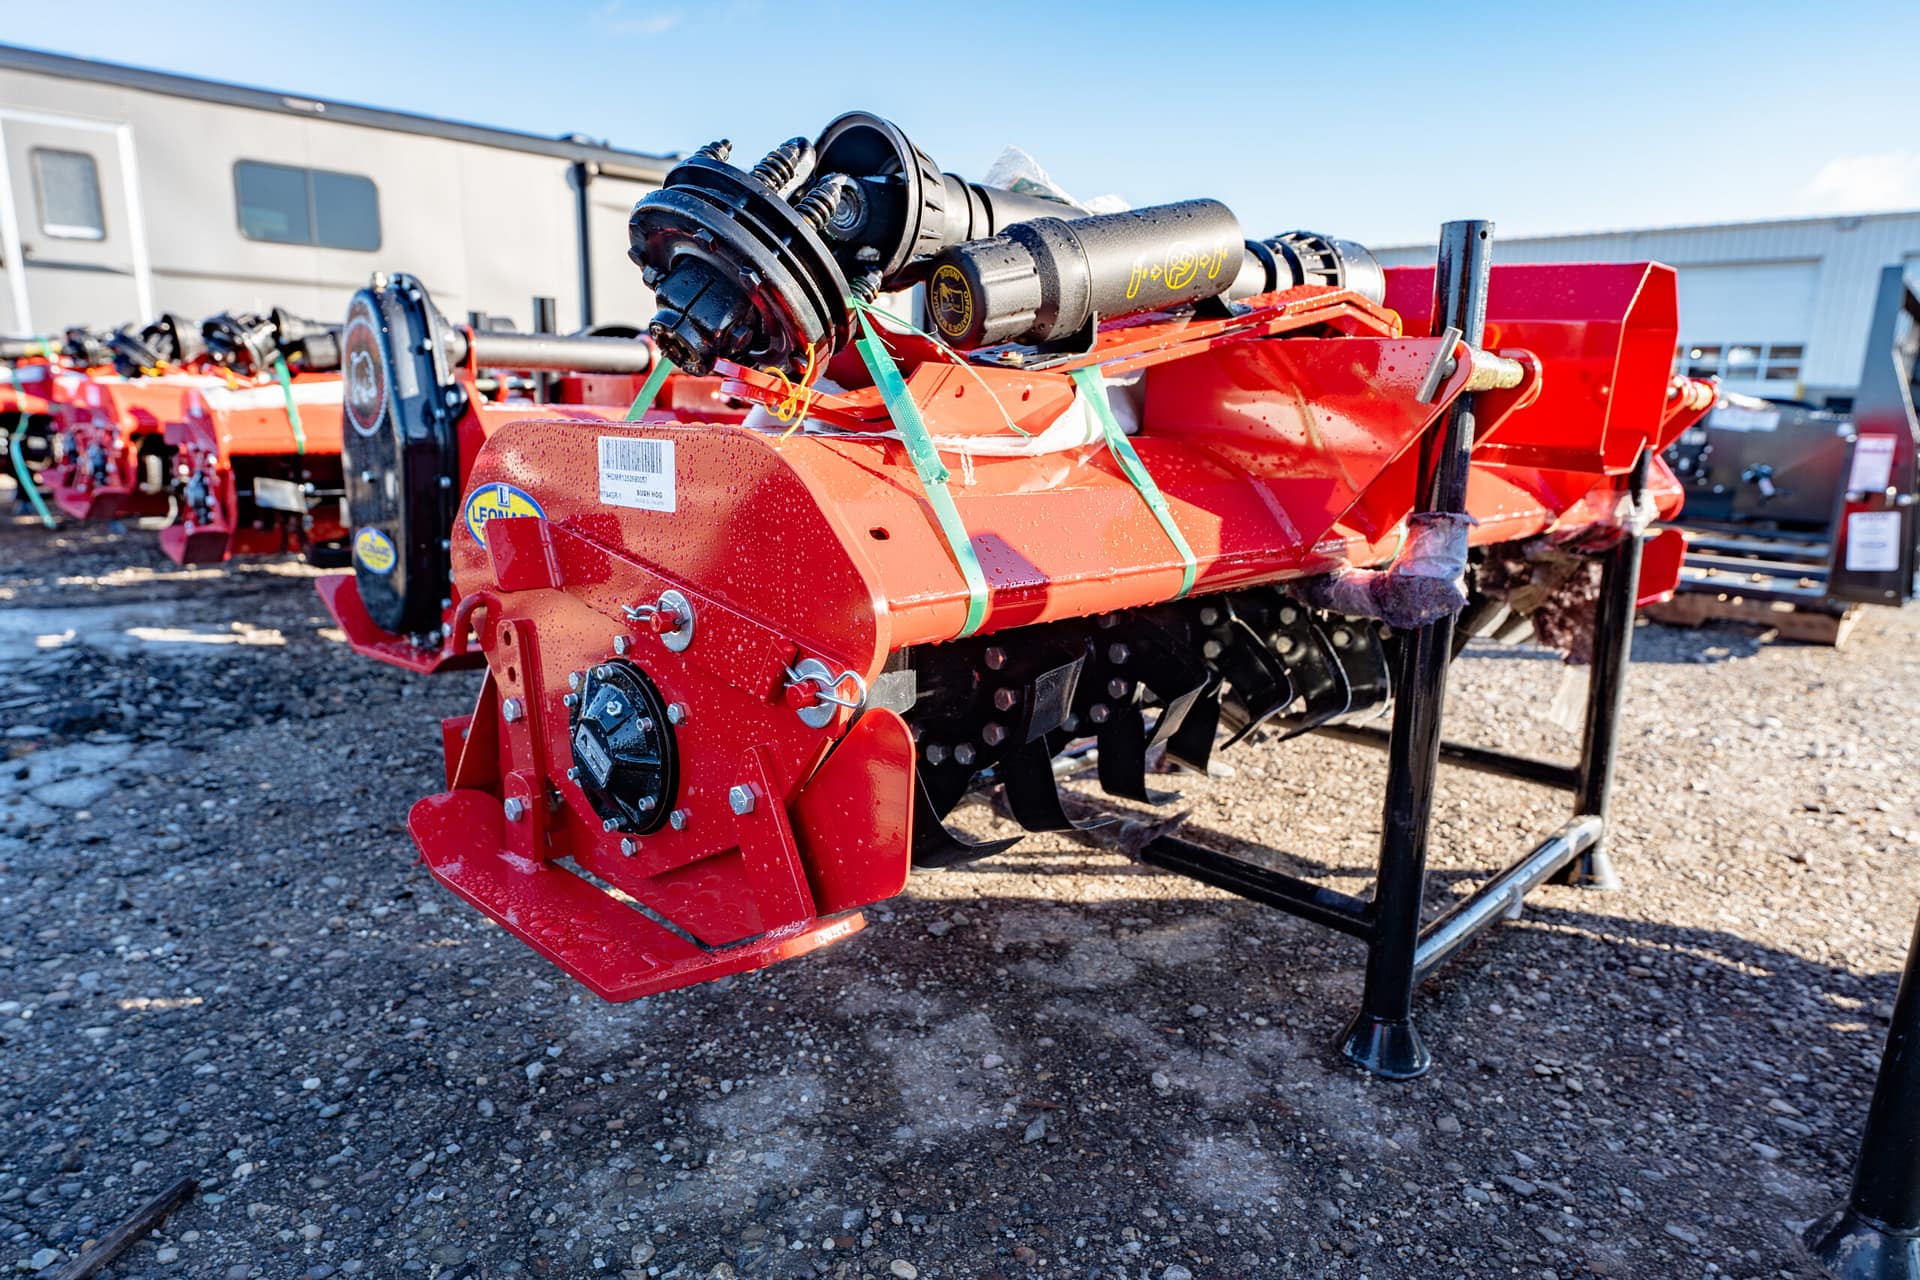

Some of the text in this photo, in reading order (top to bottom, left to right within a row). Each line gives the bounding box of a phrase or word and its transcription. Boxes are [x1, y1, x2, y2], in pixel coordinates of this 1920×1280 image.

[636, 489, 664, 499] BUSH HOG
[472, 505, 534, 523] LEON
